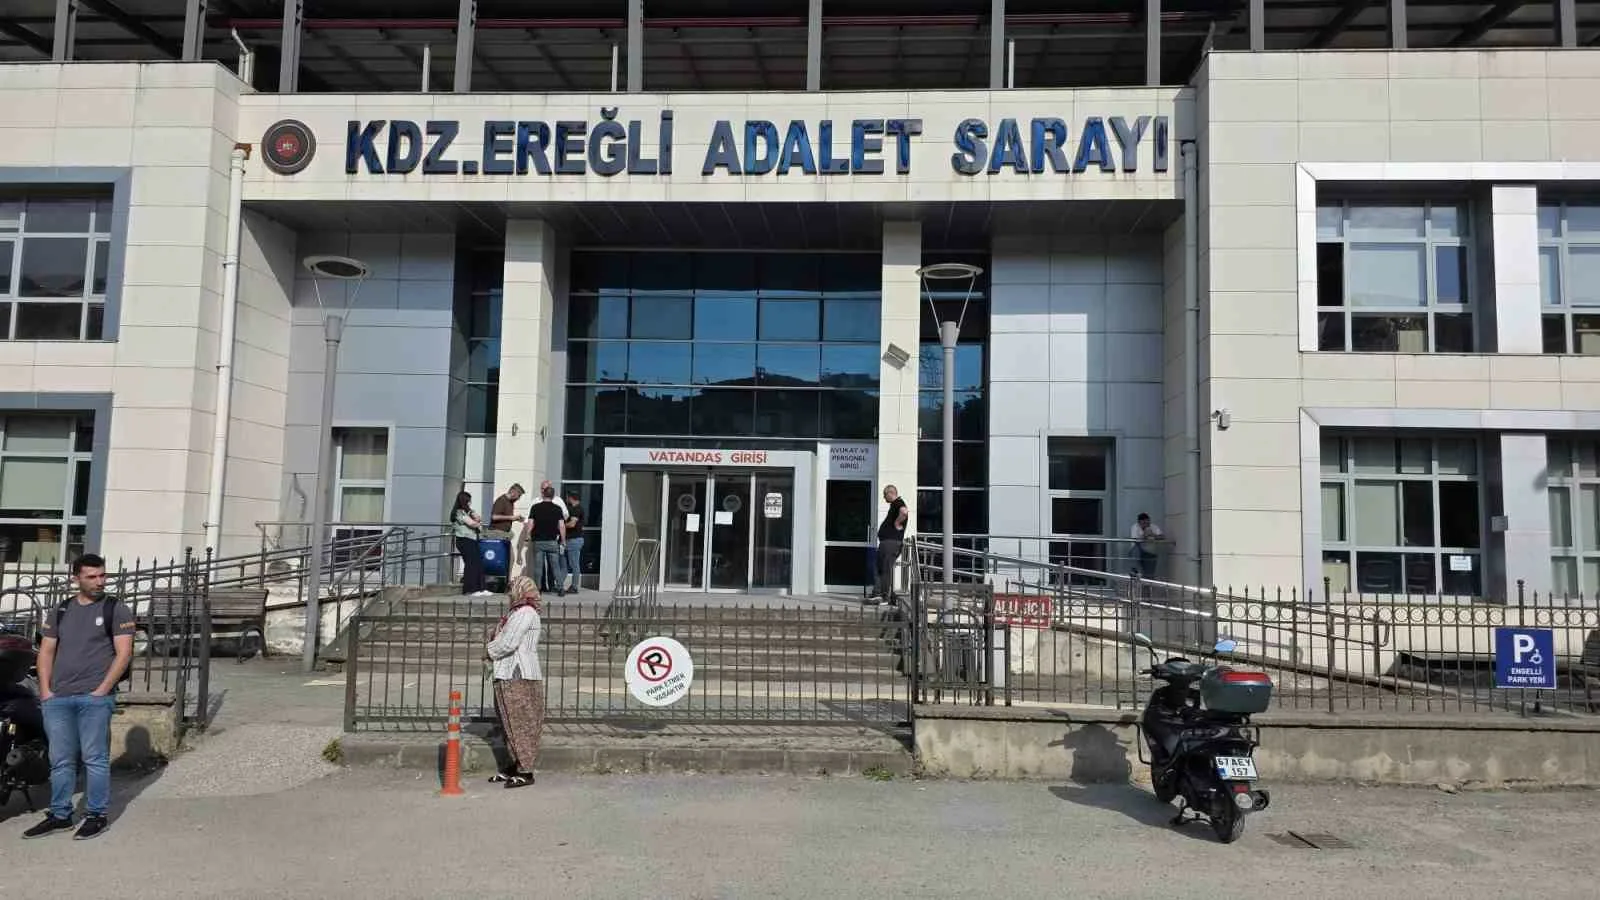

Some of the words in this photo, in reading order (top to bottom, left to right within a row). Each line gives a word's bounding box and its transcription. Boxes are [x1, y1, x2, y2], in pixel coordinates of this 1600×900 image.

[346, 107, 673, 176] KDZ.EREĞLİ
[702, 118, 923, 175] ADALET
[951, 115, 1169, 175] SARAYI
[649, 451, 722, 464] VATANDAŞ
[731, 452, 767, 464] GİRİŞİ
[1513, 634, 1534, 663] P
[1511, 667, 1542, 675] ENGELLİ
[1529, 675, 1546, 684] YERİ
[646, 685, 664, 696] PARK
